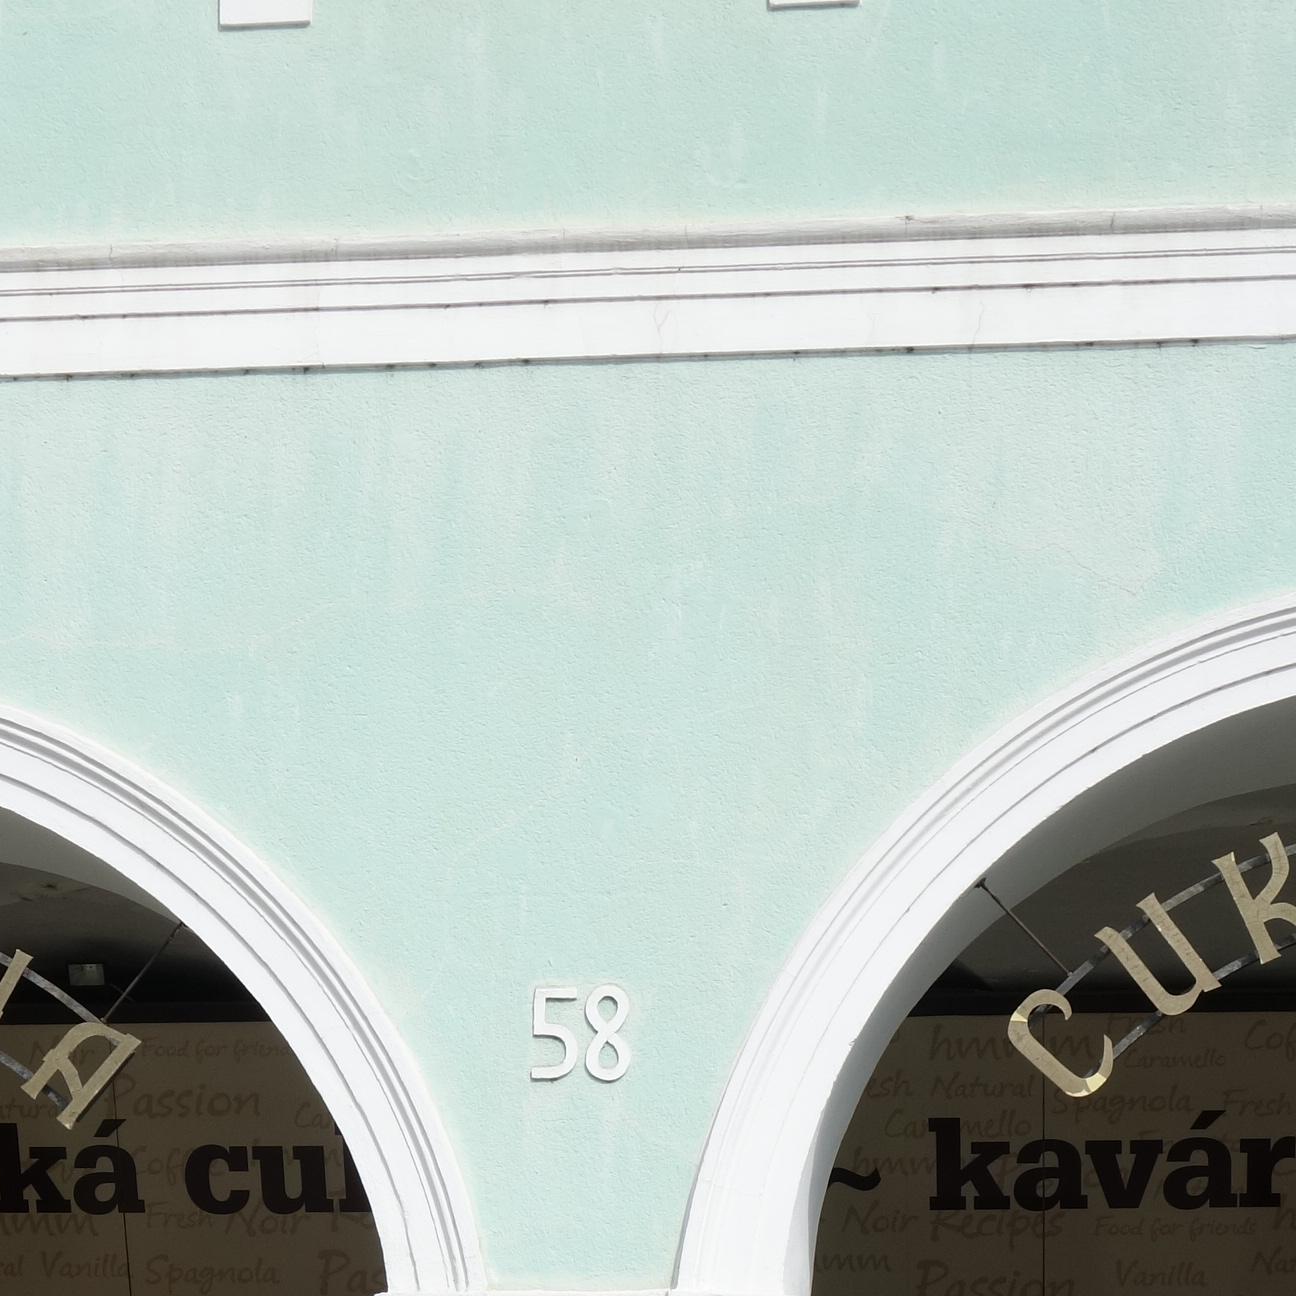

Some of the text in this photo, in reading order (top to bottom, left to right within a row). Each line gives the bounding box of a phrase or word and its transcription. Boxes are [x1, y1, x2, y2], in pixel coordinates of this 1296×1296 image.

[530, 983, 632, 1083] 58
[841, 1203, 920, 1235] Noir
[144, 1253, 280, 1294] Spagnola
[1114, 1259, 1209, 1288] Vanilla
